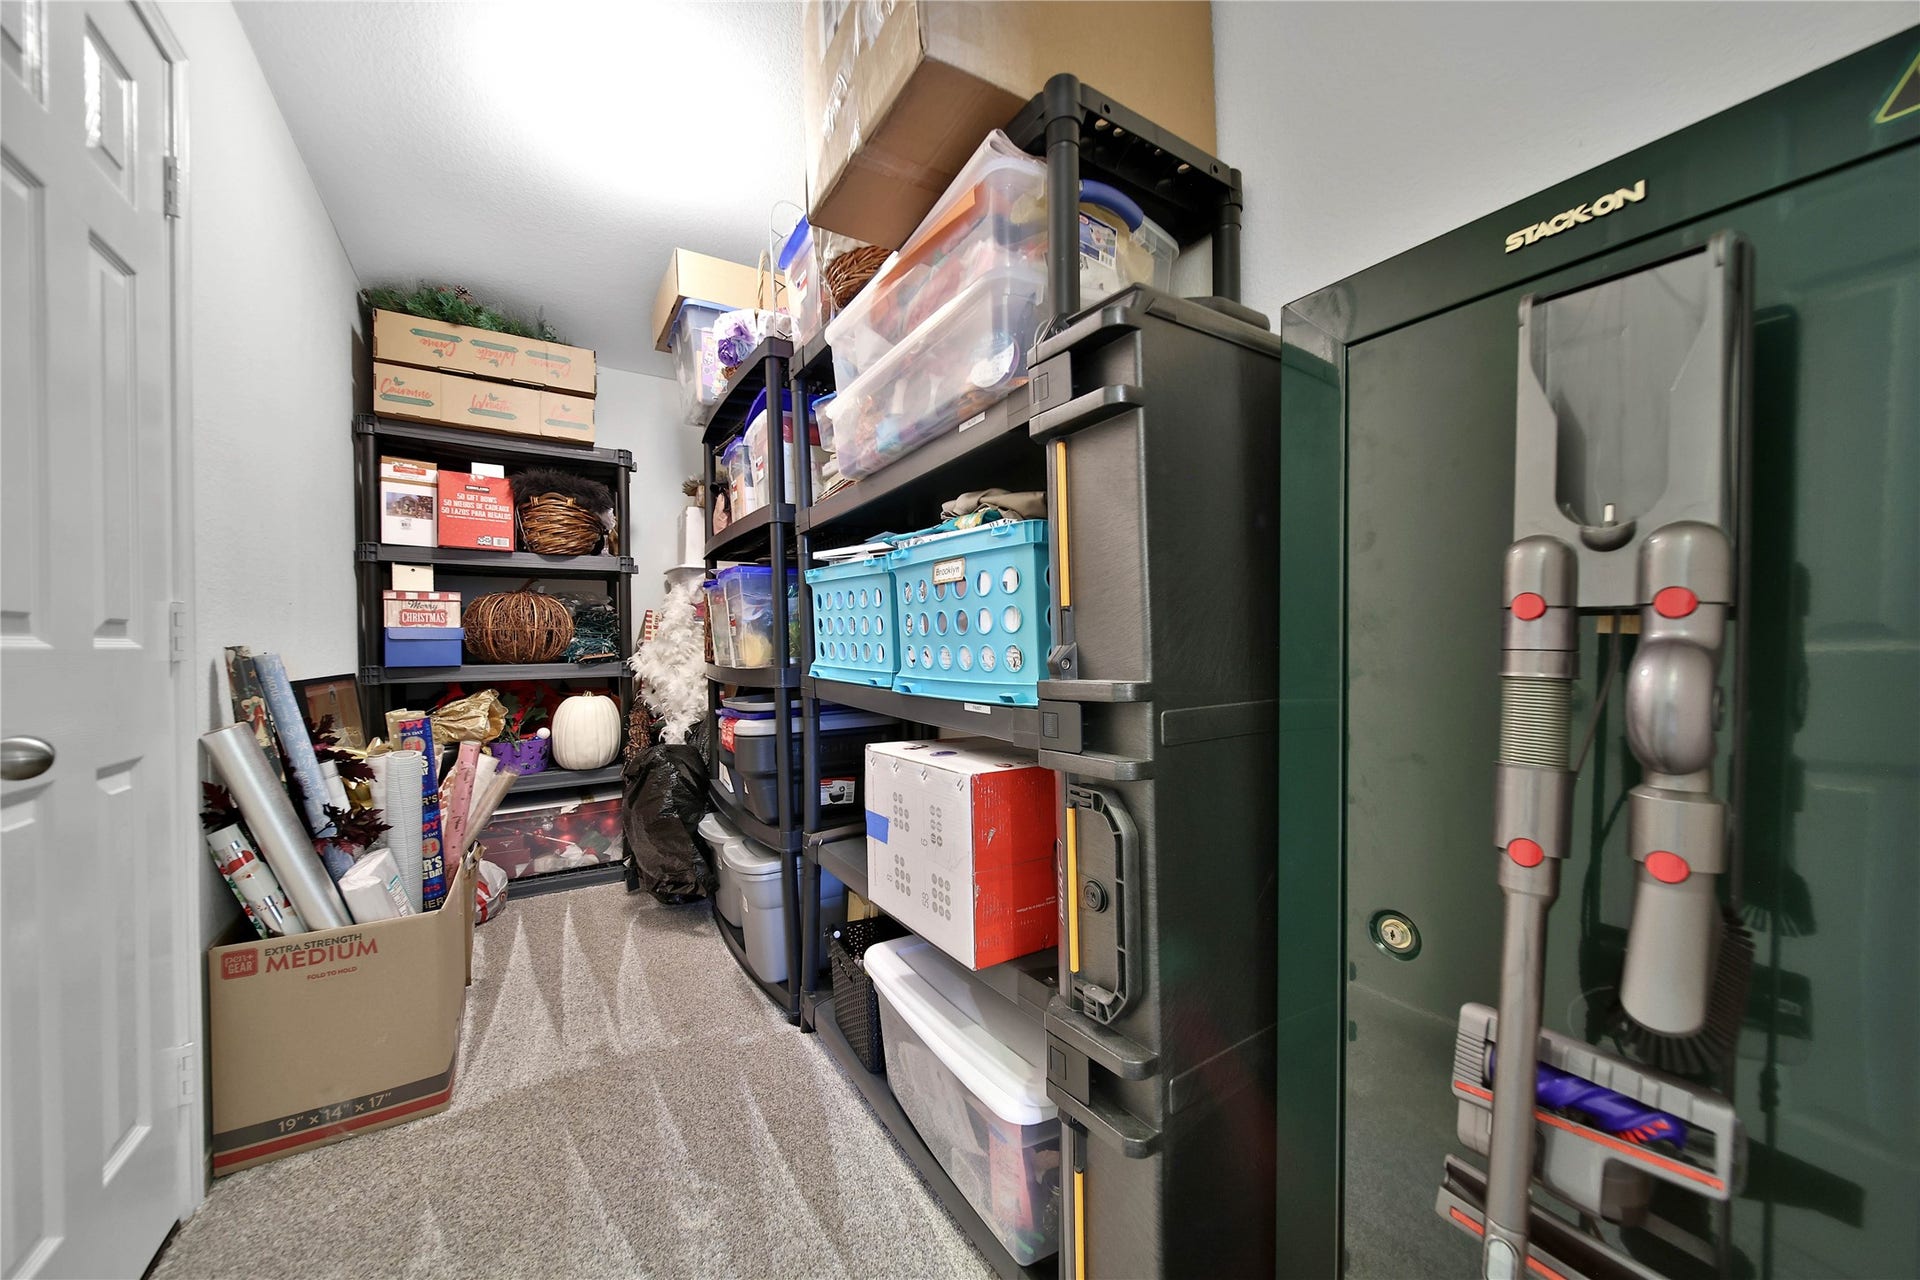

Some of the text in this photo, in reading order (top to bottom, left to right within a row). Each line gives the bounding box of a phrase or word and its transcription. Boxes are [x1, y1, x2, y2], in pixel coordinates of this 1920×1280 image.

[1505, 179, 1646, 254] STACK-ON
[443, 498, 452, 507] 50
[441, 506, 450, 514] 50
[407, 600, 439, 611] Merry
[401, 610, 446, 624] CHRISTMAS
[264, 933, 363, 957] EXTRA STRENGTH
[265, 938, 379, 973] MEDIUM
[228, 960, 253, 974] GEAR
[307, 972, 326, 981] FOLD
[337, 966, 358, 975] HOLD
[309, 1115, 319, 1125] x
[355, 1102, 364, 1113] x
